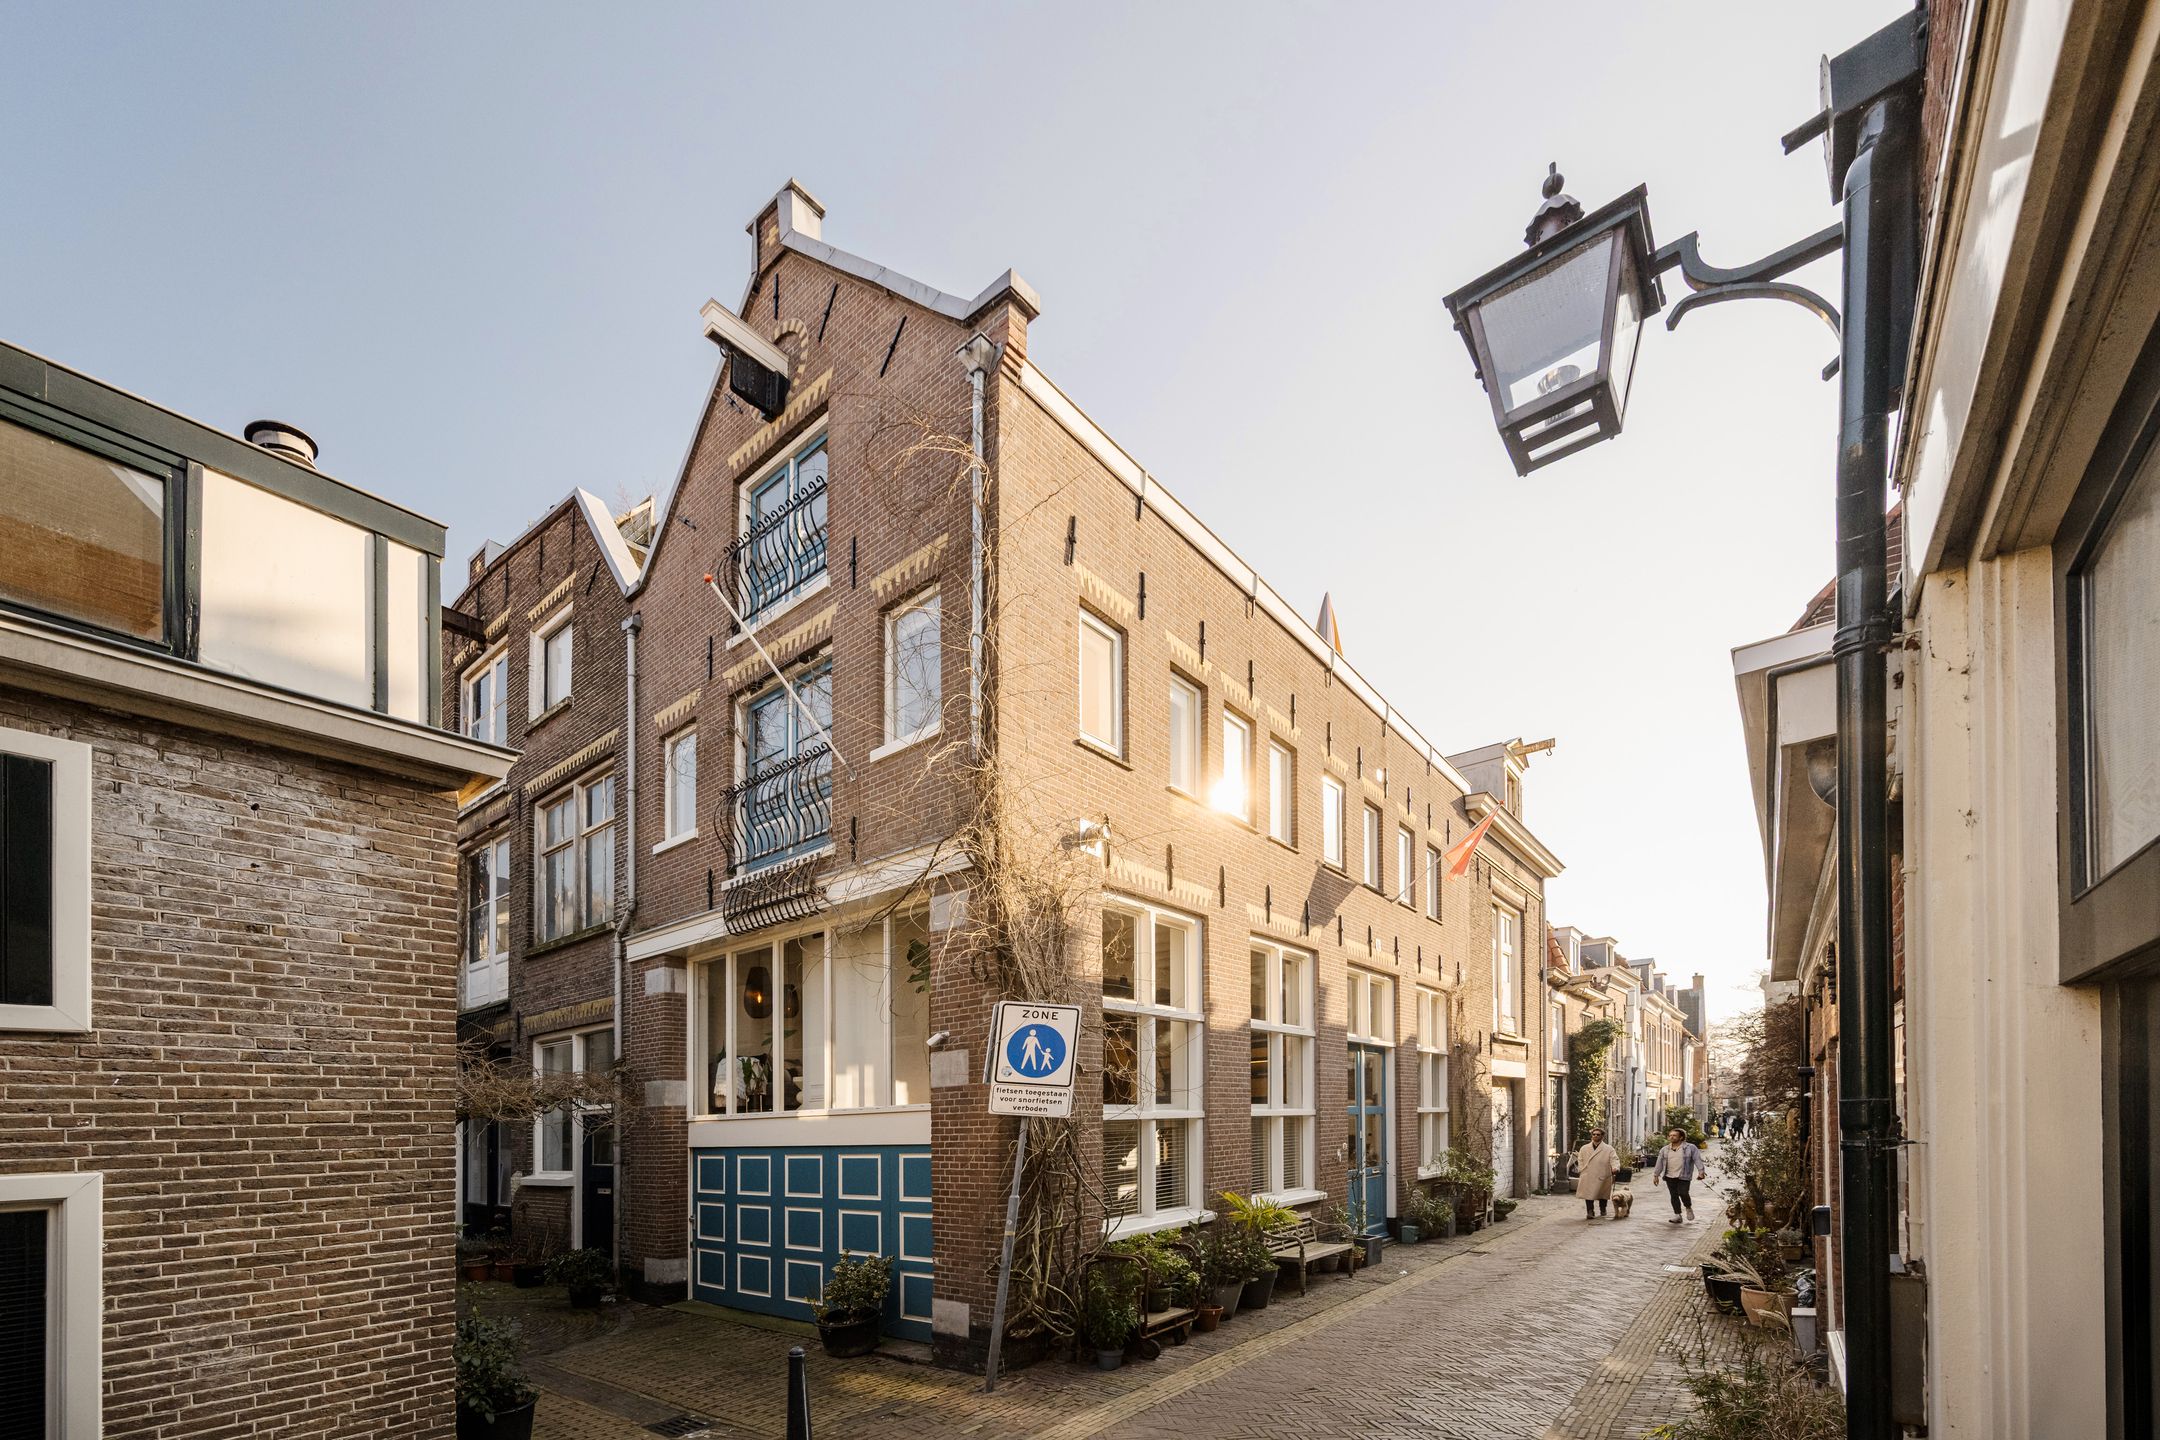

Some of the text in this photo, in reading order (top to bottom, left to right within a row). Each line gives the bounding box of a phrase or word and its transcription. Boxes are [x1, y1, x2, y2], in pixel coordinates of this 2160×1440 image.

[1022, 1009, 1059, 1021] ZONE
[996, 1087, 1068, 1097] fietsen toegestaan
[1018, 1097, 1063, 1105] snorfietsen
[1012, 1105, 1048, 1113] verboden
